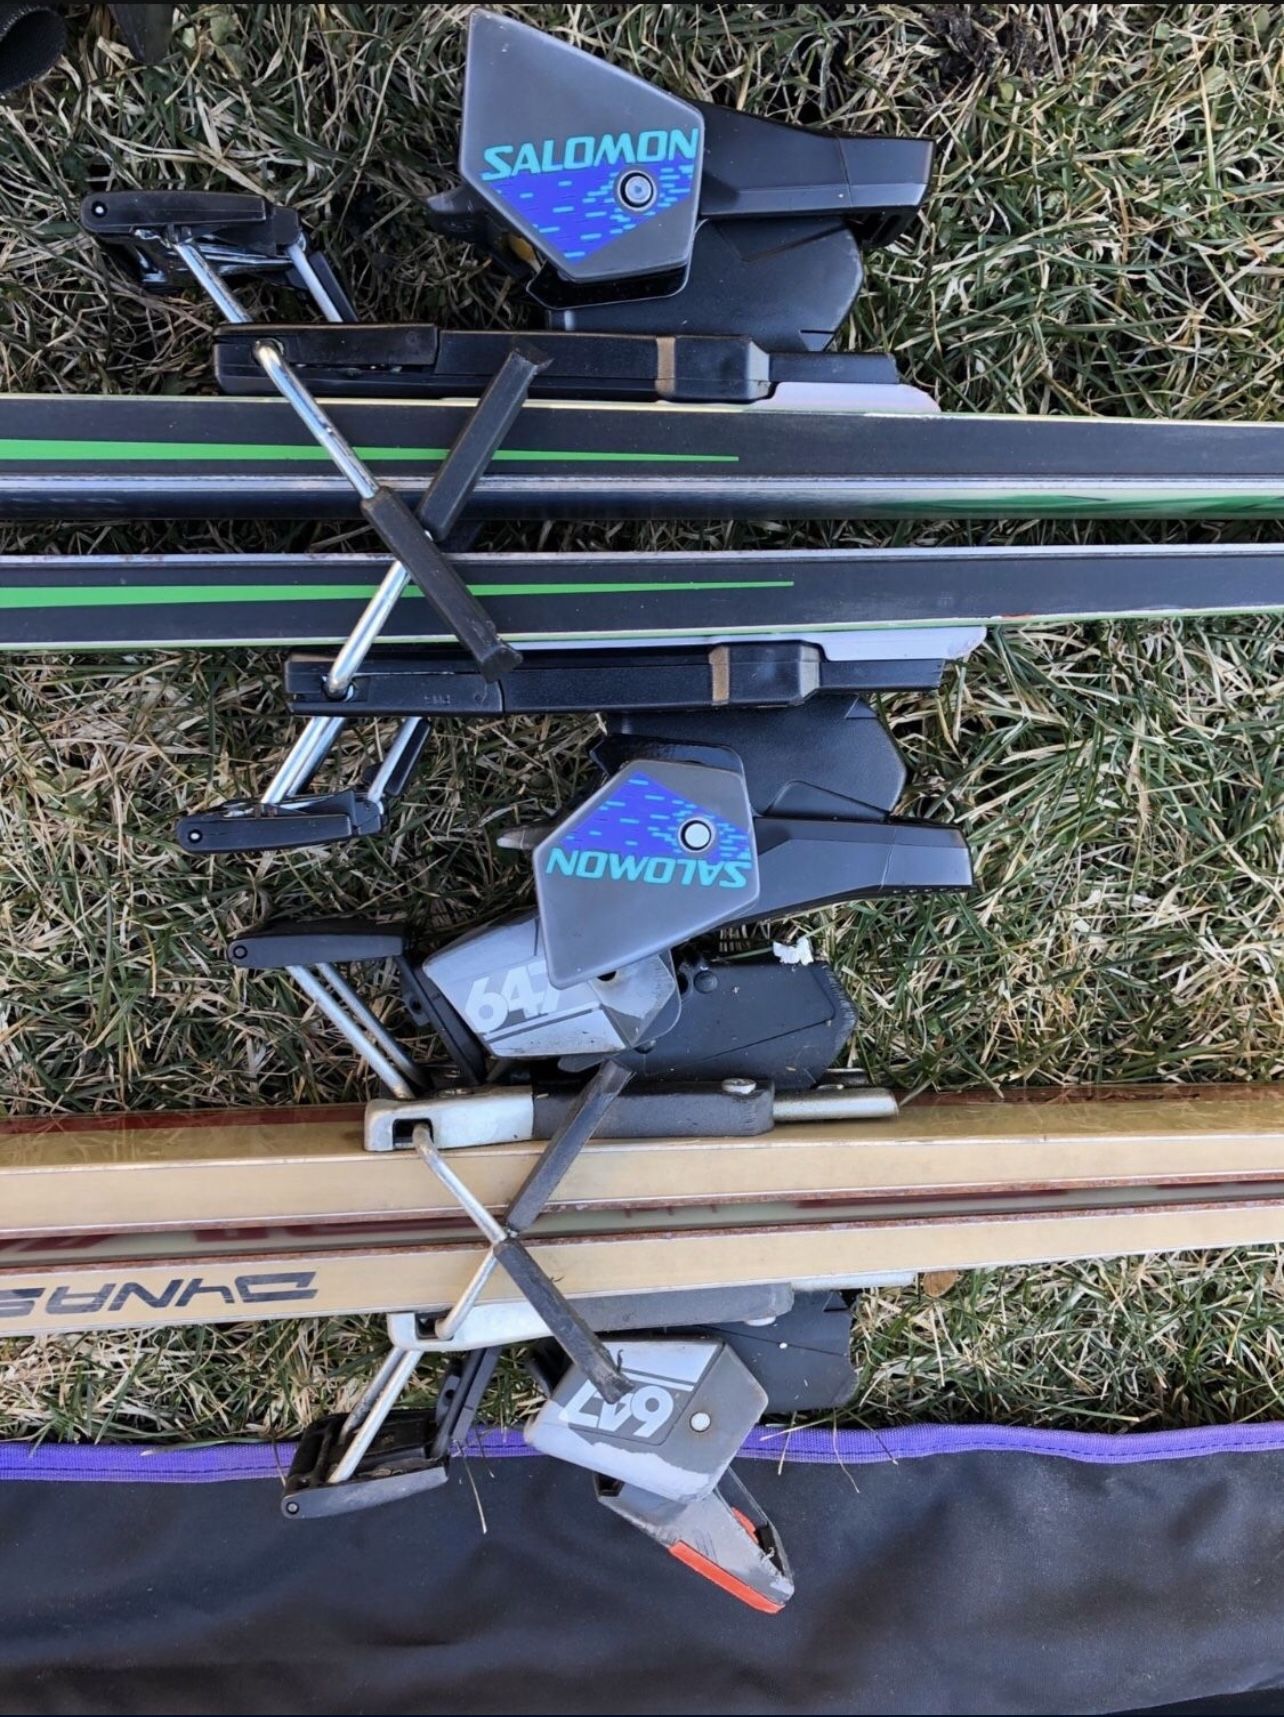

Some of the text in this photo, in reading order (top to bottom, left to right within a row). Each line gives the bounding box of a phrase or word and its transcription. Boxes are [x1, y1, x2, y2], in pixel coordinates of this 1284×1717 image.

[481, 128, 699, 181] SALOMON
[545, 848, 752, 888] SALOMON
[559, 1379, 674, 1438] 647
